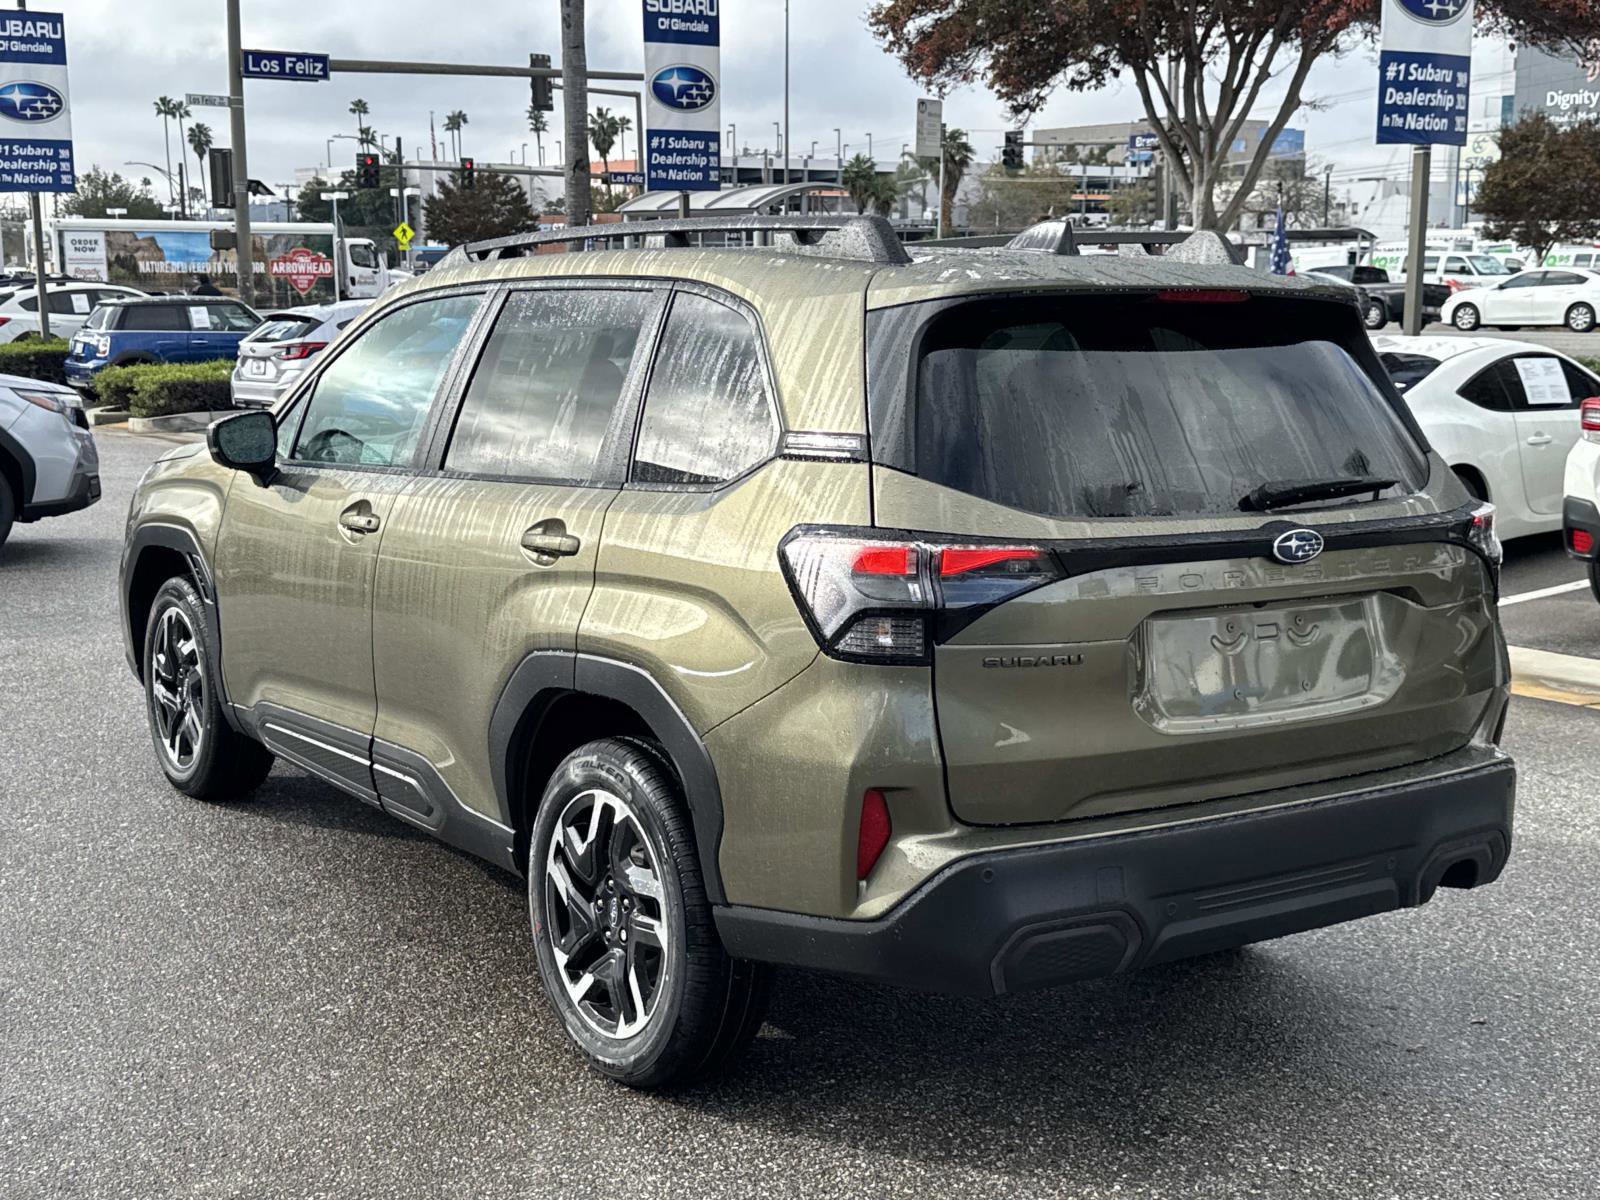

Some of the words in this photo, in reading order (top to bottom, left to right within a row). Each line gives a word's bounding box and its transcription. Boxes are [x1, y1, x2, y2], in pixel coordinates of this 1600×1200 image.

[646, 0, 717, 16] SUBARU
[0, 19, 62, 39] UBARU
[658, 18, 670, 30] Of
[671, 18, 709, 33] Glendale
[10, 41, 53, 53] Glendale
[248, 54, 280, 73] Los
[285, 57, 324, 76] Feliz
[1385, 62, 1406, 81] #1
[1408, 63, 1453, 83] Subaru
[1384, 87, 1455, 112] Dealership
[1546, 89, 1600, 110] Dignity
[1382, 113, 1391, 127] In
[1391, 113, 1404, 128] The
[1404, 112, 1449, 131] Nation
[0, 145, 9, 156] 1
[12, 144, 54, 157] Subaru
[650, 136, 666, 149] #1
[668, 136, 705, 150] Subaru
[651, 152, 707, 168] Dealership
[13, 173, 53, 184] Nation
[611, 174, 625, 183] Los
[626, 174, 644, 184] Feliz
[650, 170, 657, 179] In
[657, 170, 667, 179] The
[667, 168, 703, 181] Nation
[138, 261, 171, 273] NATURE
[224, 261, 239, 274] YOU
[271, 261, 332, 274] ARROWHEAD
[1134, 556, 1422, 594] FORESTER
[982, 653, 1085, 669] SUBARU
[575, 760, 625, 784] FALKEN
